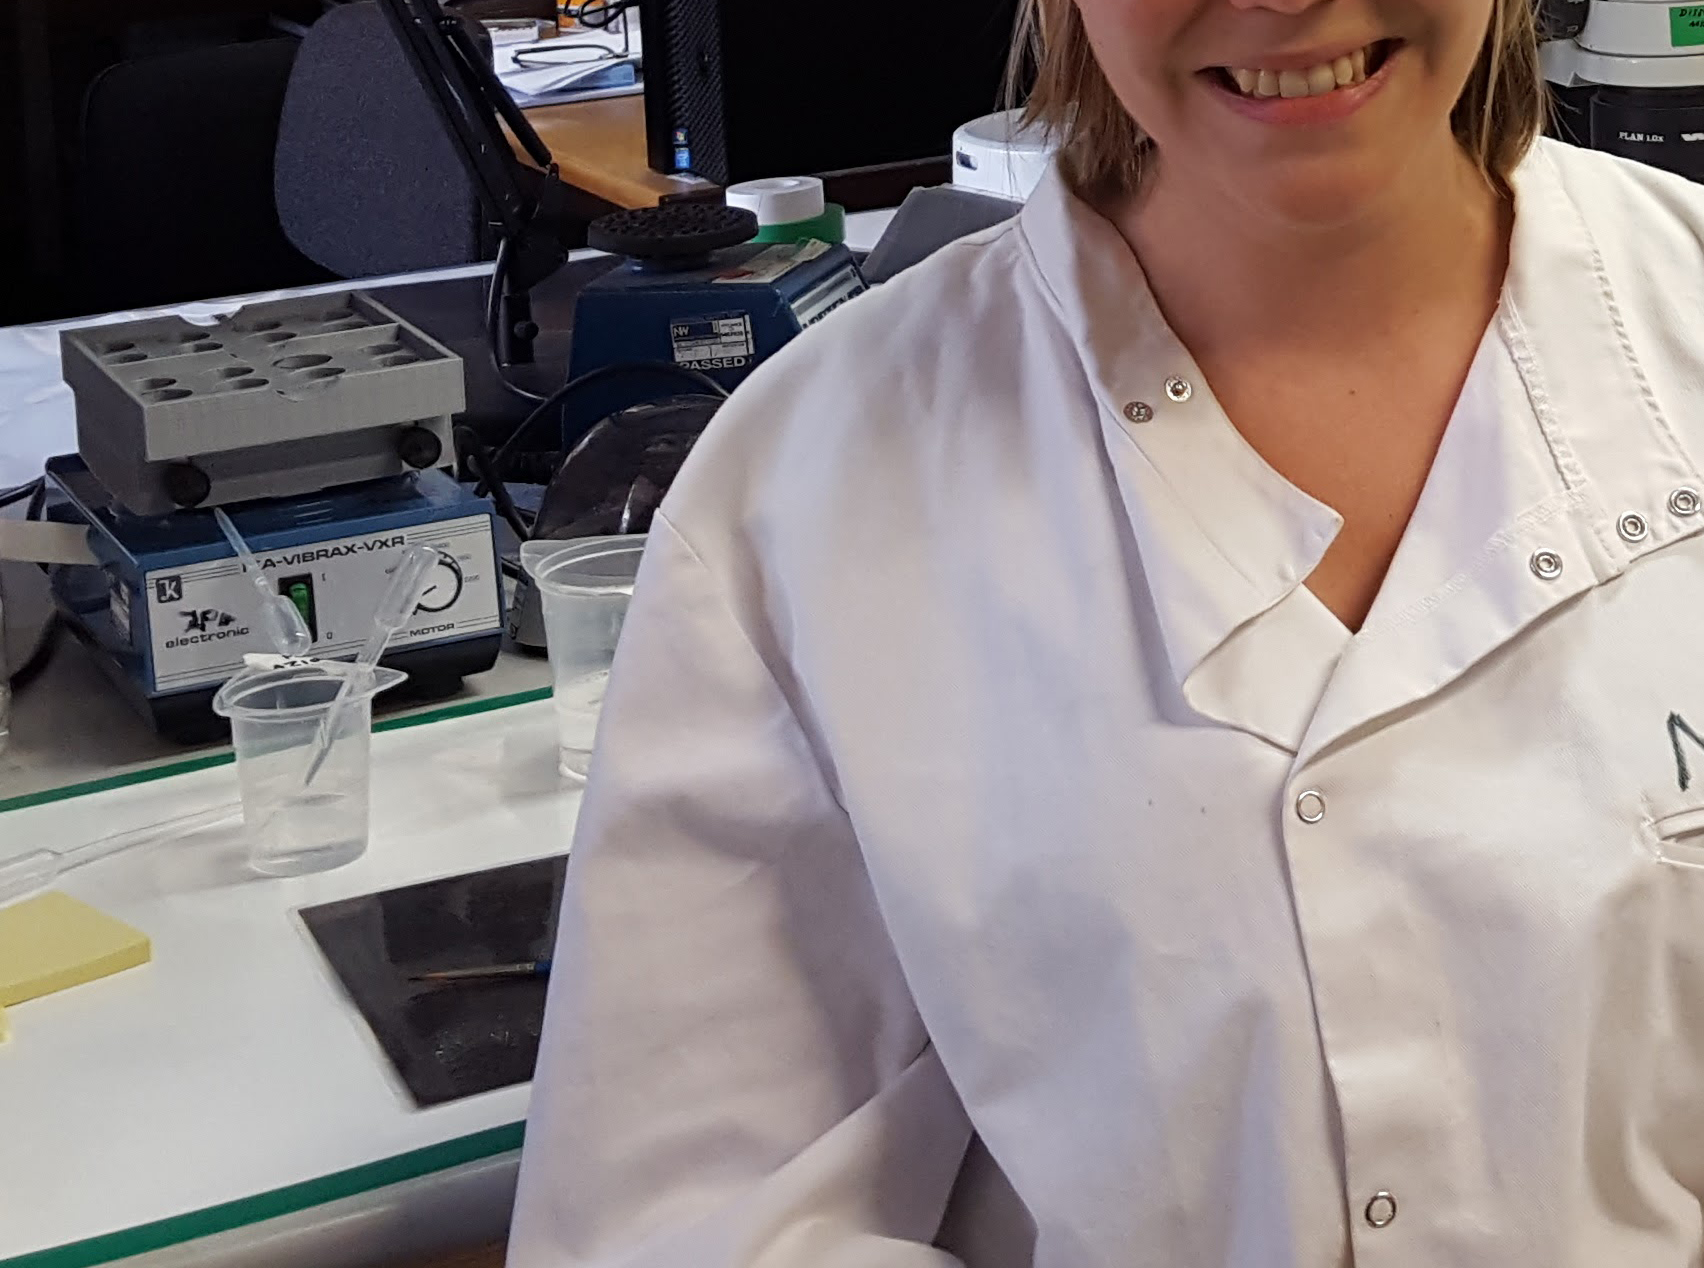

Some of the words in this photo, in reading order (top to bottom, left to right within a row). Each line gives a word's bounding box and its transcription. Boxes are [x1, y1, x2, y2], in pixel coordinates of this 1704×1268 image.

[1618, 131, 1643, 142] PLAN
[680, 356, 746, 370] PASSED
[242, 535, 406, 574] IA-VIBRAX-VXR
[410, 623, 455, 637] MOTOR
[165, 627, 250, 649] electronic
